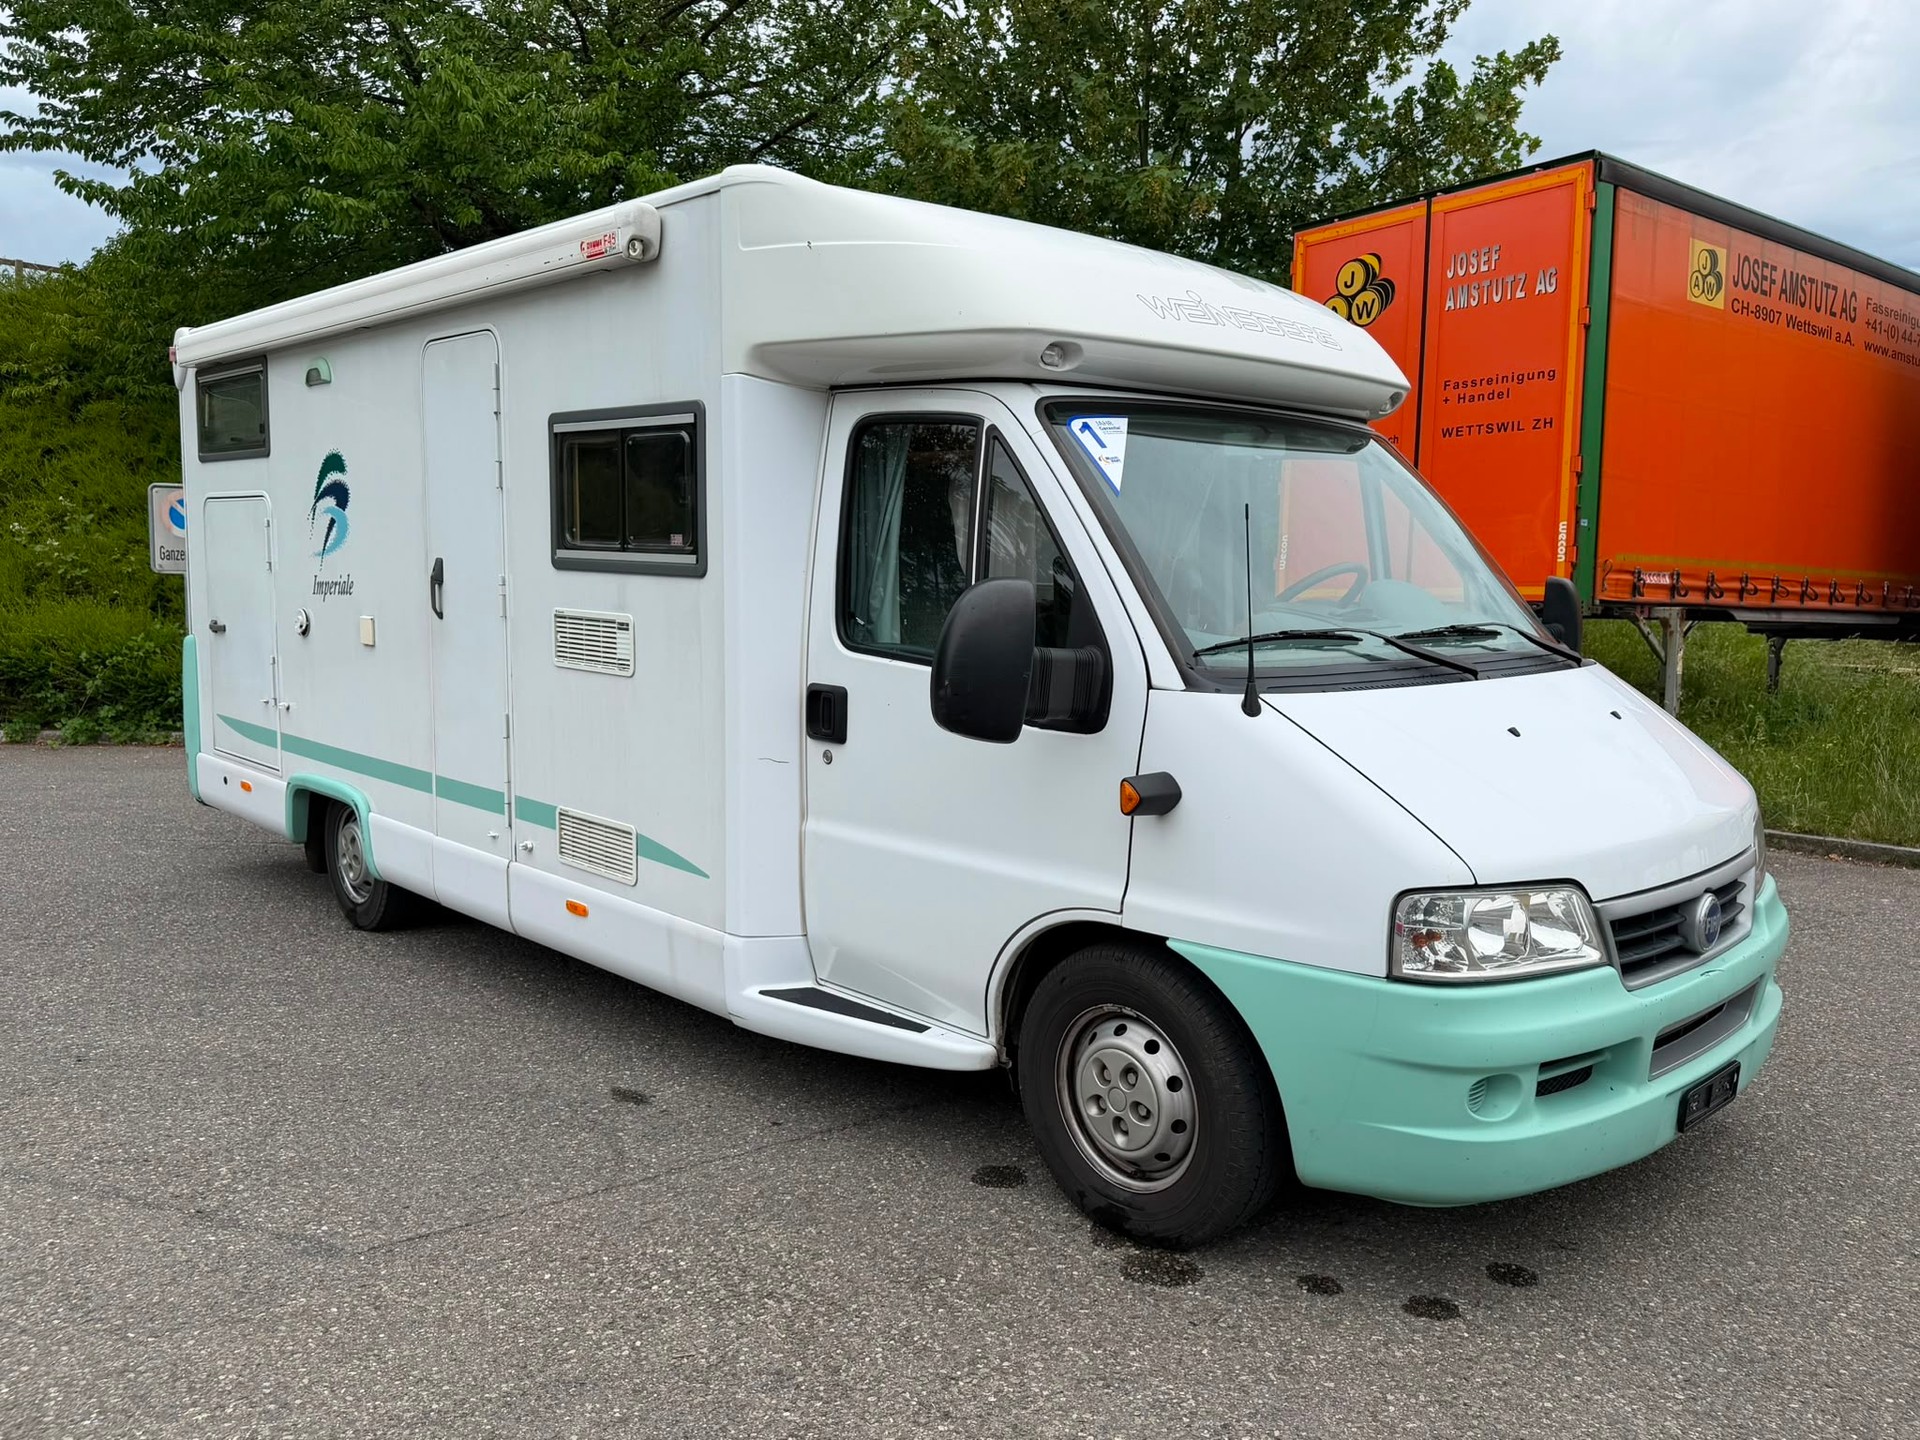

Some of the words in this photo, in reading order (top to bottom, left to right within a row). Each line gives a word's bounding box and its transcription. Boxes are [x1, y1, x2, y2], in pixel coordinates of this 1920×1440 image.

[1446, 244, 1502, 279] JOSEF
[1444, 272, 1528, 312] AMSTUTZ
[1534, 267, 1558, 296] AG
[1732, 253, 1778, 298] JOSEF
[1778, 269, 1839, 318] AMSTUTZ
[1839, 290, 1858, 323] AG
[1731, 298, 1782, 326] CH-8907
[1785, 313, 1832, 341] Wettswil
[1835, 331, 1855, 347] a.A.
[1865, 318, 1900, 344] +41-(0)
[1863, 340, 1920, 368] www.amstu
[1443, 369, 1557, 391] Fassreinigung
[1457, 388, 1511, 404] Handel
[1441, 420, 1526, 438] WETTSWIL
[1532, 417, 1554, 430] ZH
[159, 545, 186, 562] Ganze
[1279, 534, 1288, 570] wecon
[1557, 521, 1567, 562] wecon
[312, 573, 354, 602] Imperiale
